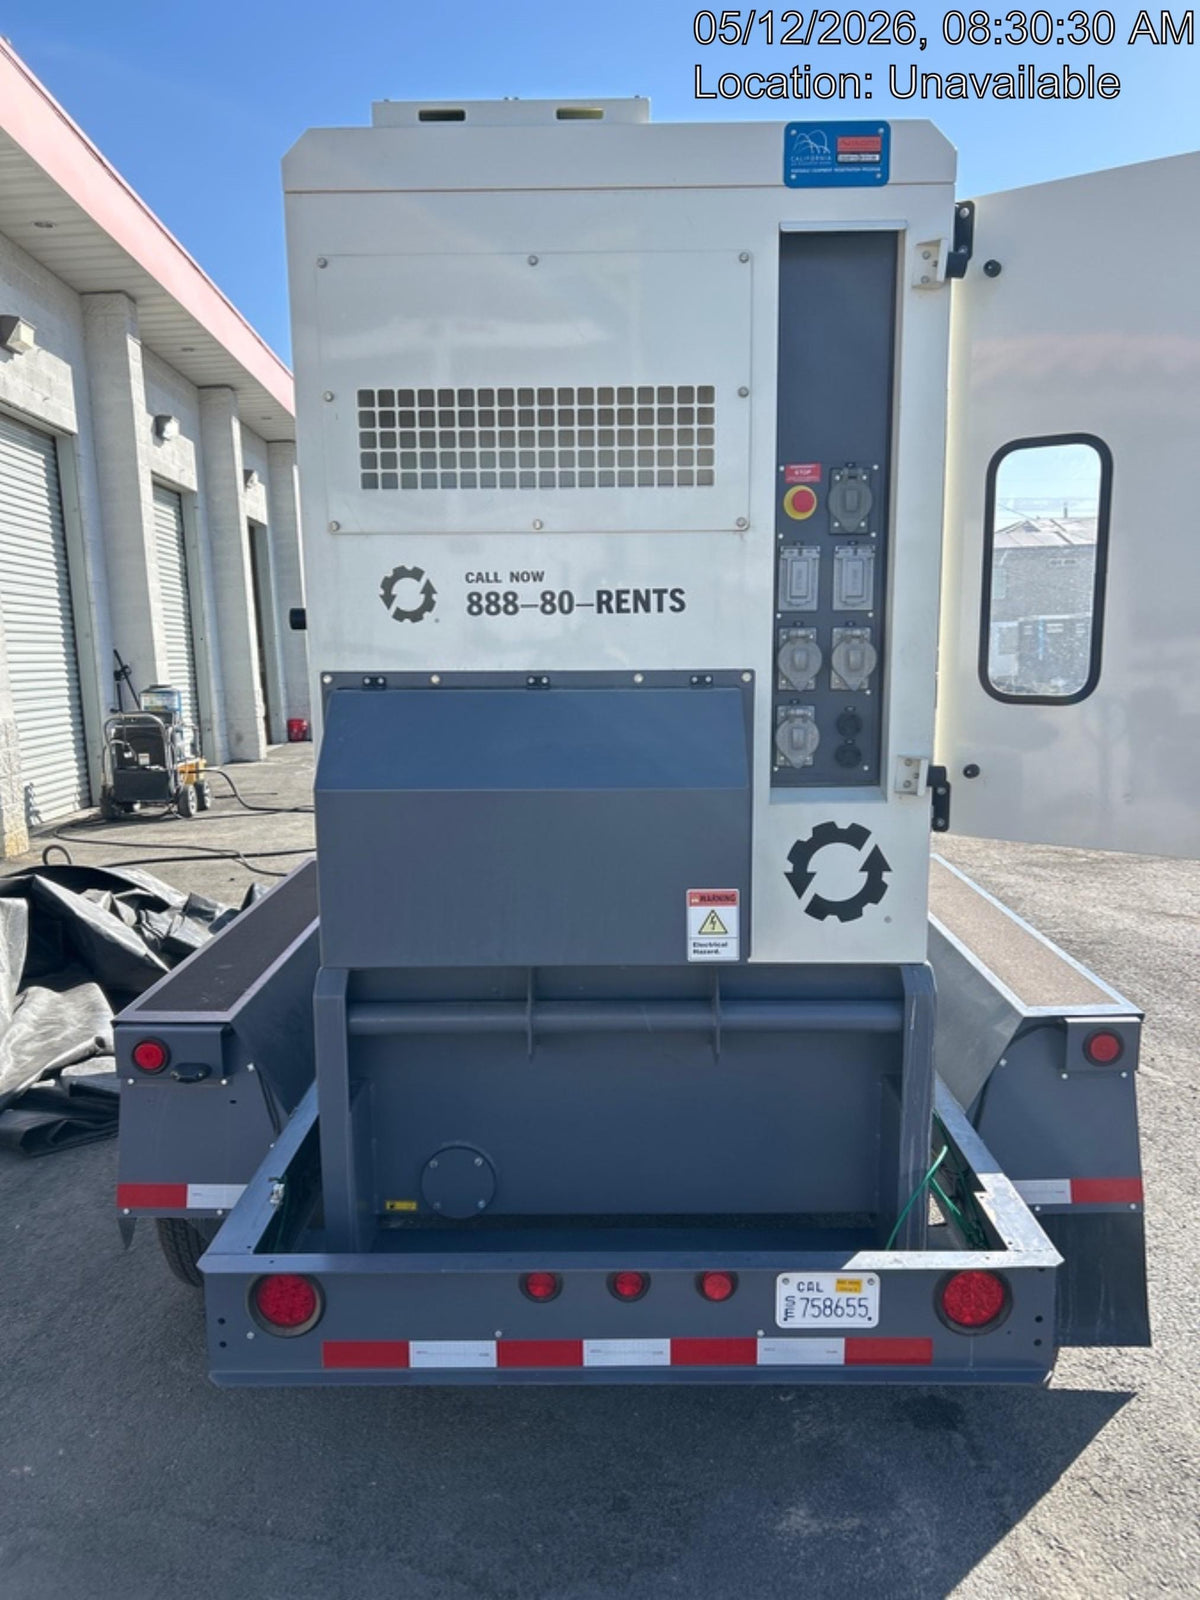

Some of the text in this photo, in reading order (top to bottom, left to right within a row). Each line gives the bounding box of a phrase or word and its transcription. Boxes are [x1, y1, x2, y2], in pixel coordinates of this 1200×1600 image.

[465, 571, 545, 584] CALL NOW
[700, 893, 737, 902] WARNING
[796, 1281, 824, 1293] CAL
[800, 1297, 869, 1318] 758655
